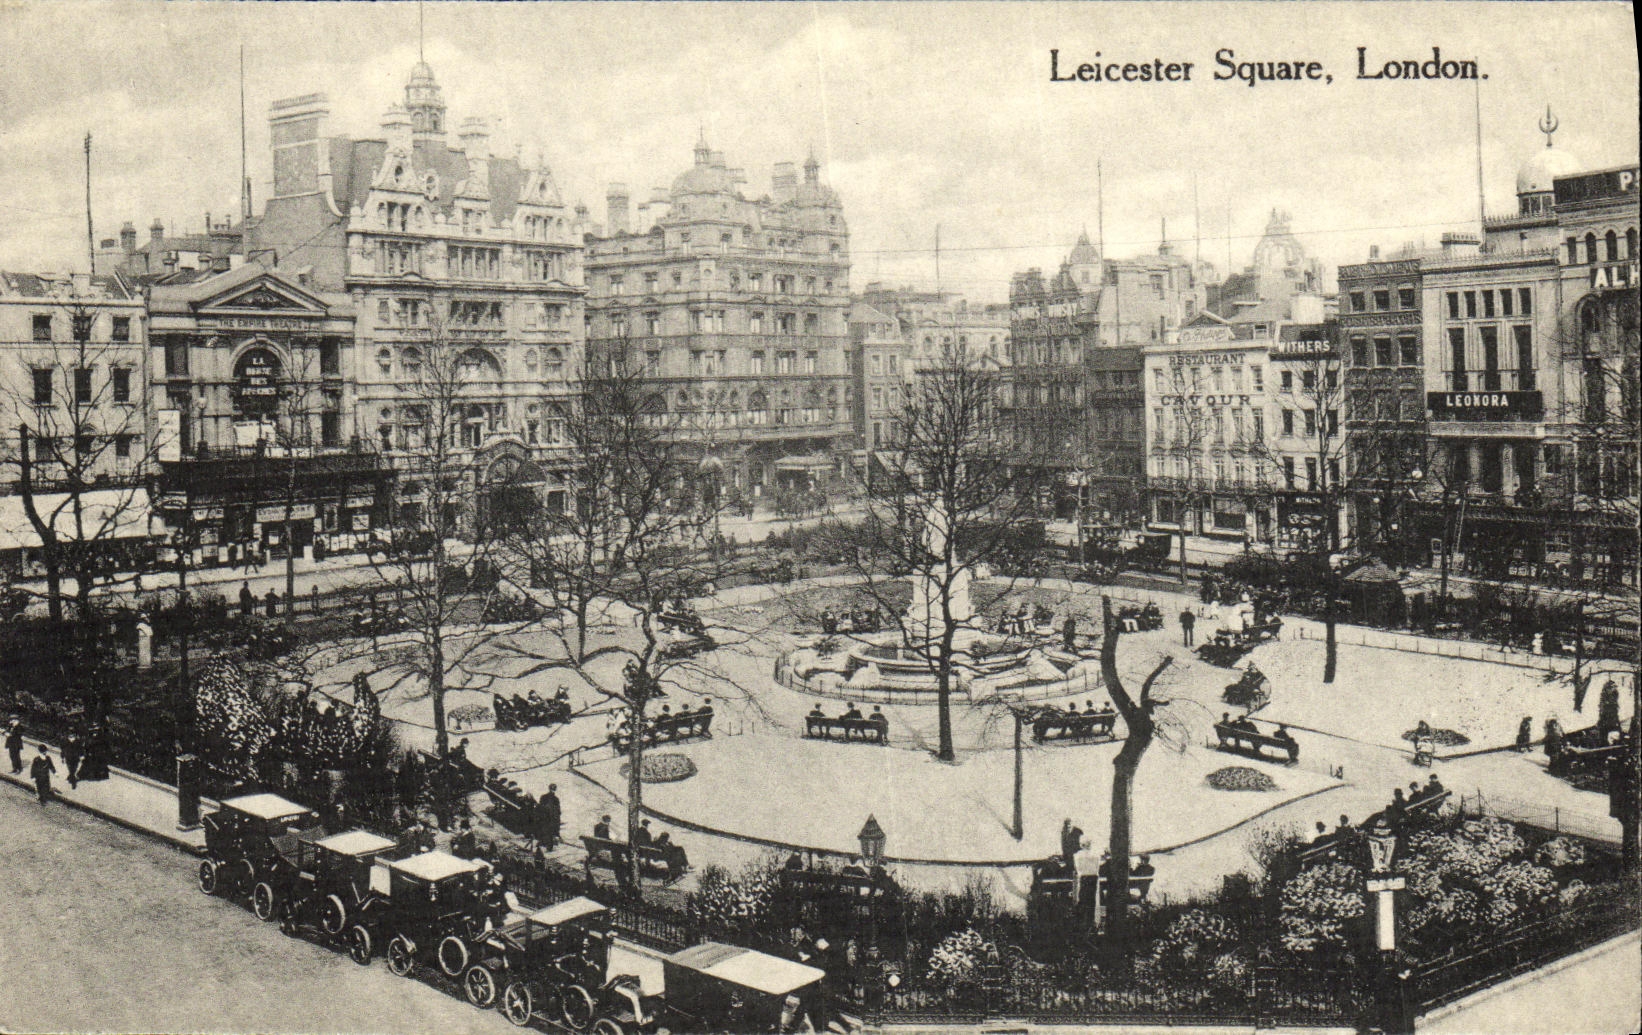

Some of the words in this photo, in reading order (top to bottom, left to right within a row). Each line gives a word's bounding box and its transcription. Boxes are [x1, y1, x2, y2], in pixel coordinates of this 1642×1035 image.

[1278, 340, 1330, 353] WITHERS
[1169, 353, 1246, 366] RESTAURANT
[1161, 395, 1251, 406] CAVOUR
[1446, 394, 1509, 407] LEONORA
